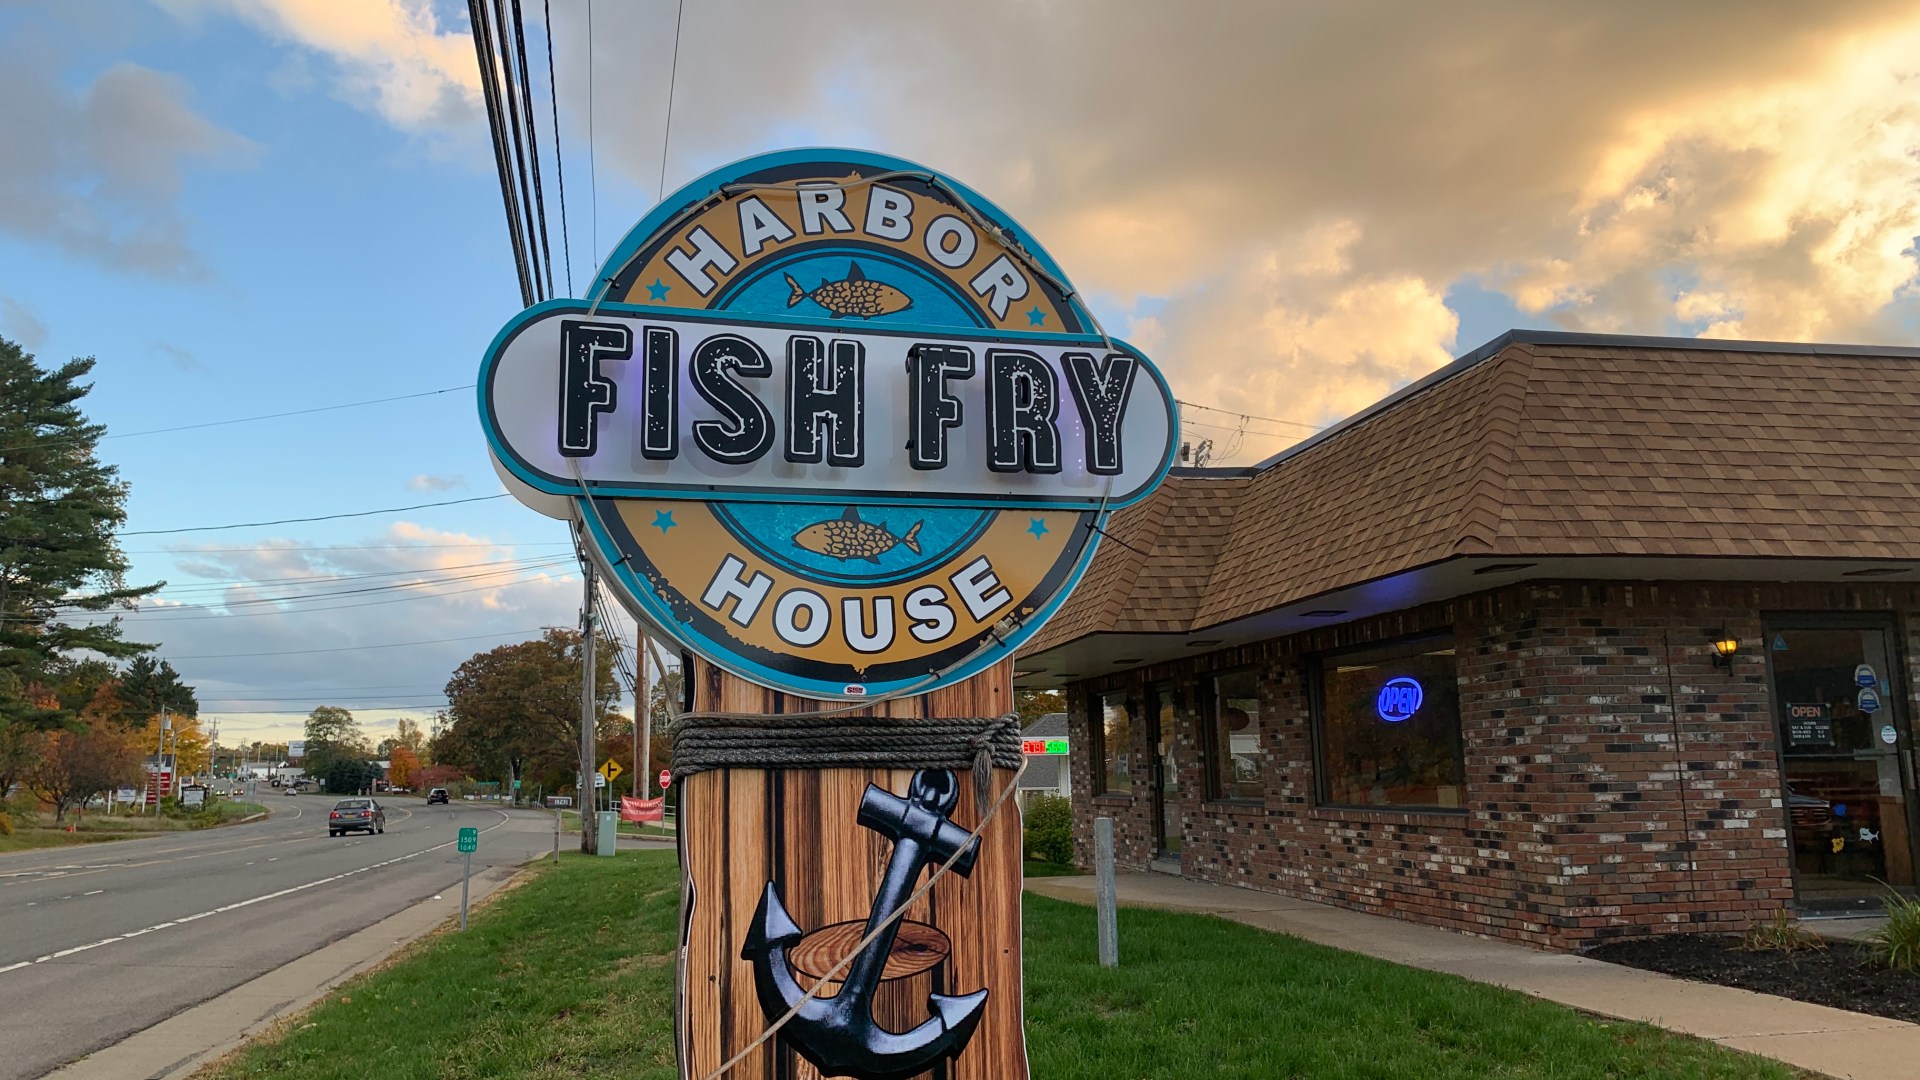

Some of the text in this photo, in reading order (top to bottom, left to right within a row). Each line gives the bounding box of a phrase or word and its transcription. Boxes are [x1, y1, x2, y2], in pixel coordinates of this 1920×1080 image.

[665, 182, 1031, 320] HARBOR
[557, 319, 1140, 476] FISH FRY
[700, 553, 1013, 653] HOUSE
[1380, 686, 1418, 714] OPEN
[1791, 706, 1821, 718] OPEN
